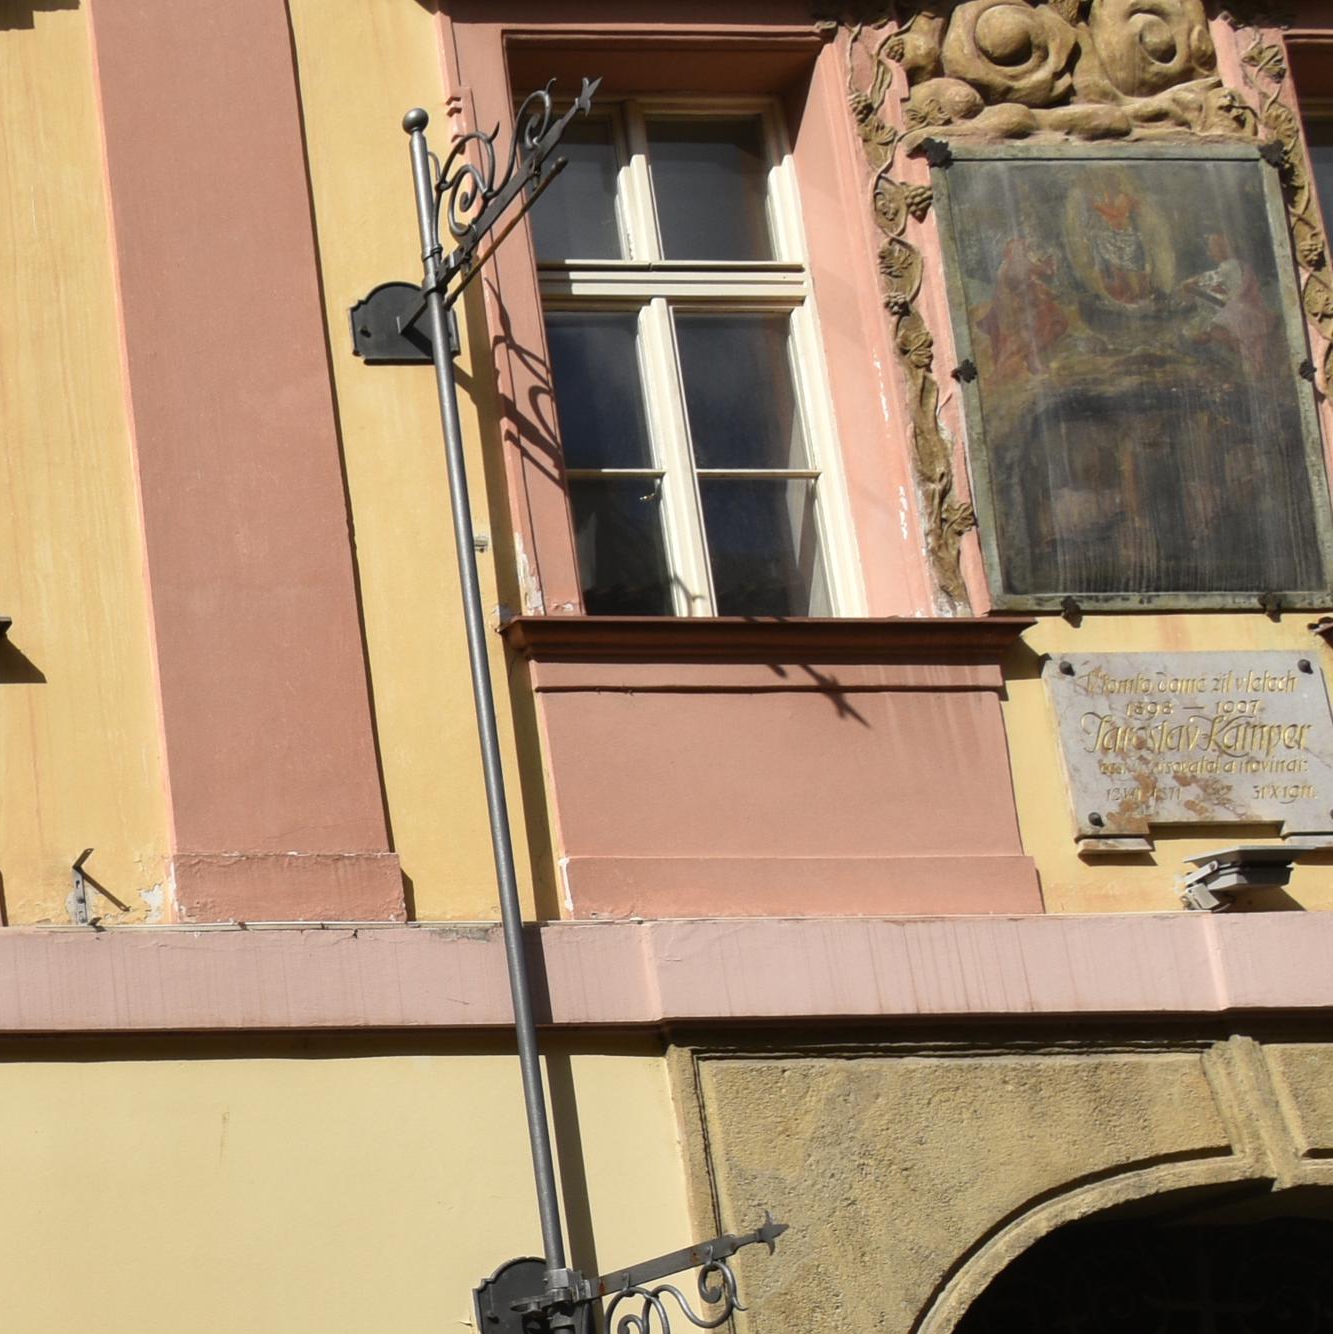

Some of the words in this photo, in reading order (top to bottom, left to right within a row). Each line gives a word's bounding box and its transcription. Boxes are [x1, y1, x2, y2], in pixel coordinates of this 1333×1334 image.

[1247, 669, 1298, 693] letech
[1126, 700, 1174, 721] 1898
[1215, 698, 1261, 717] 1907
[1080, 712, 1199, 754] Jaroslav
[1189, 714, 1313, 758] Kamper
[1223, 759, 1236, 773] a
